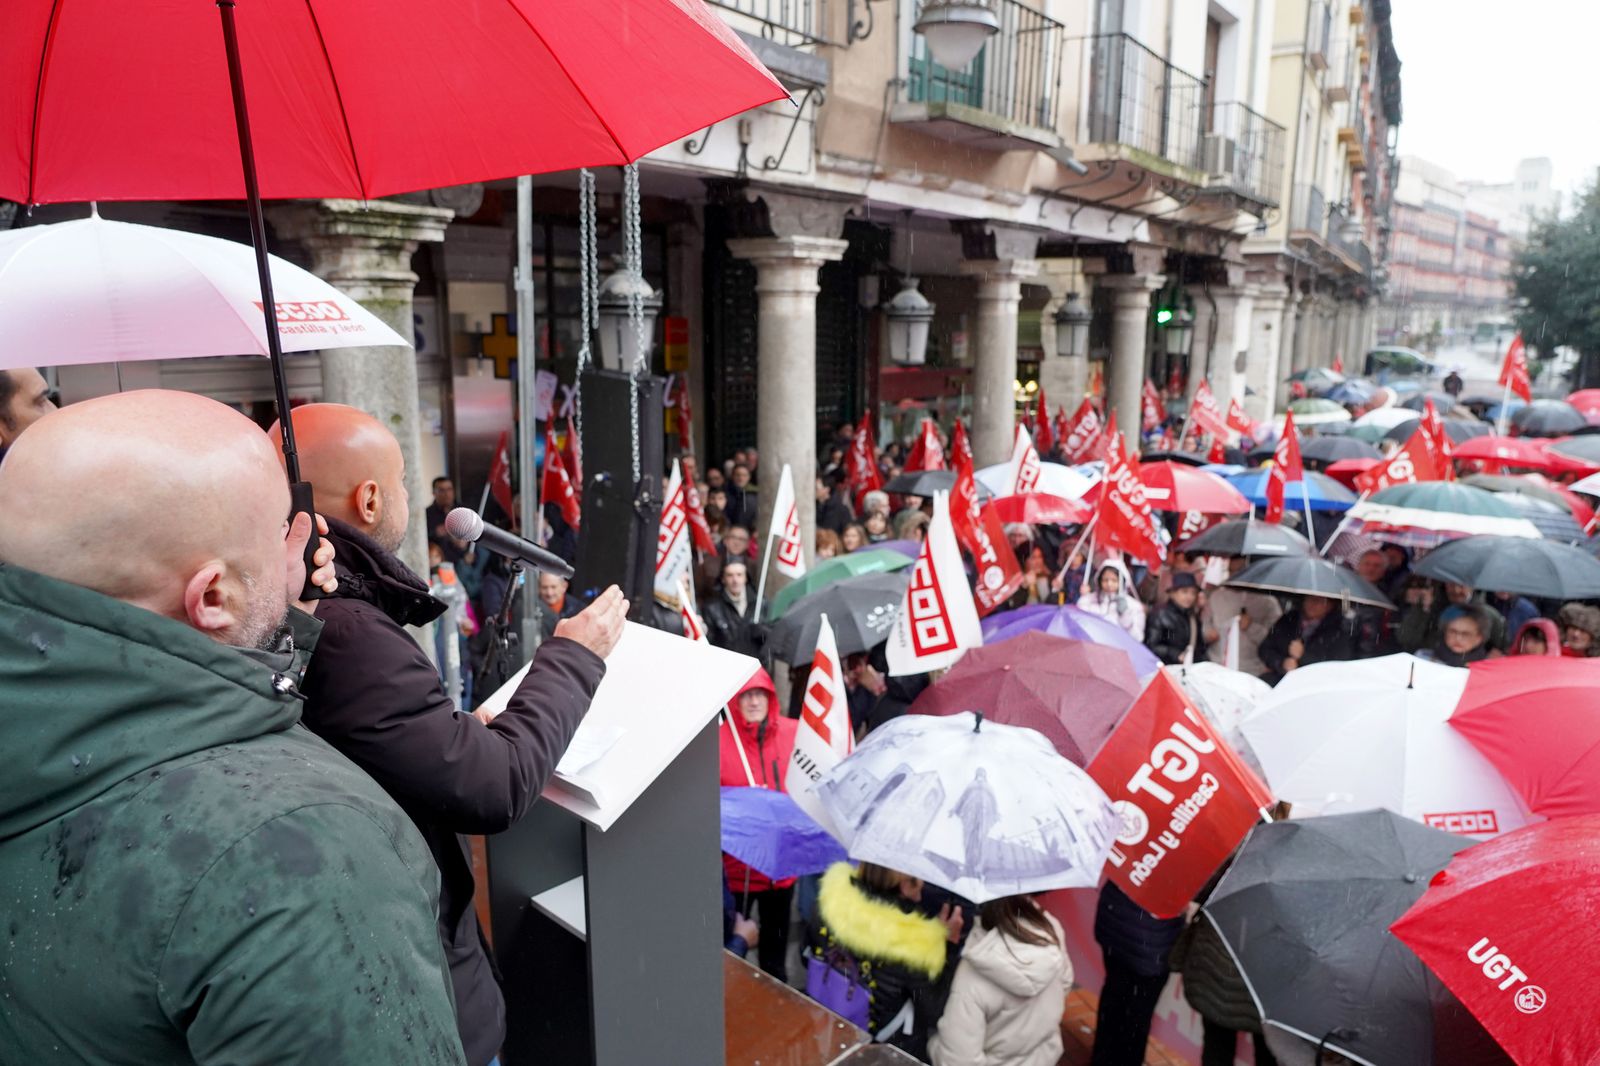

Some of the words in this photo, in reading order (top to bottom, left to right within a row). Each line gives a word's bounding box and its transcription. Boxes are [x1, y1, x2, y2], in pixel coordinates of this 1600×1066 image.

[279, 323, 327, 334] castilla
[1427, 813, 1495, 833] CCOO
[1467, 937, 1528, 991] UGT
